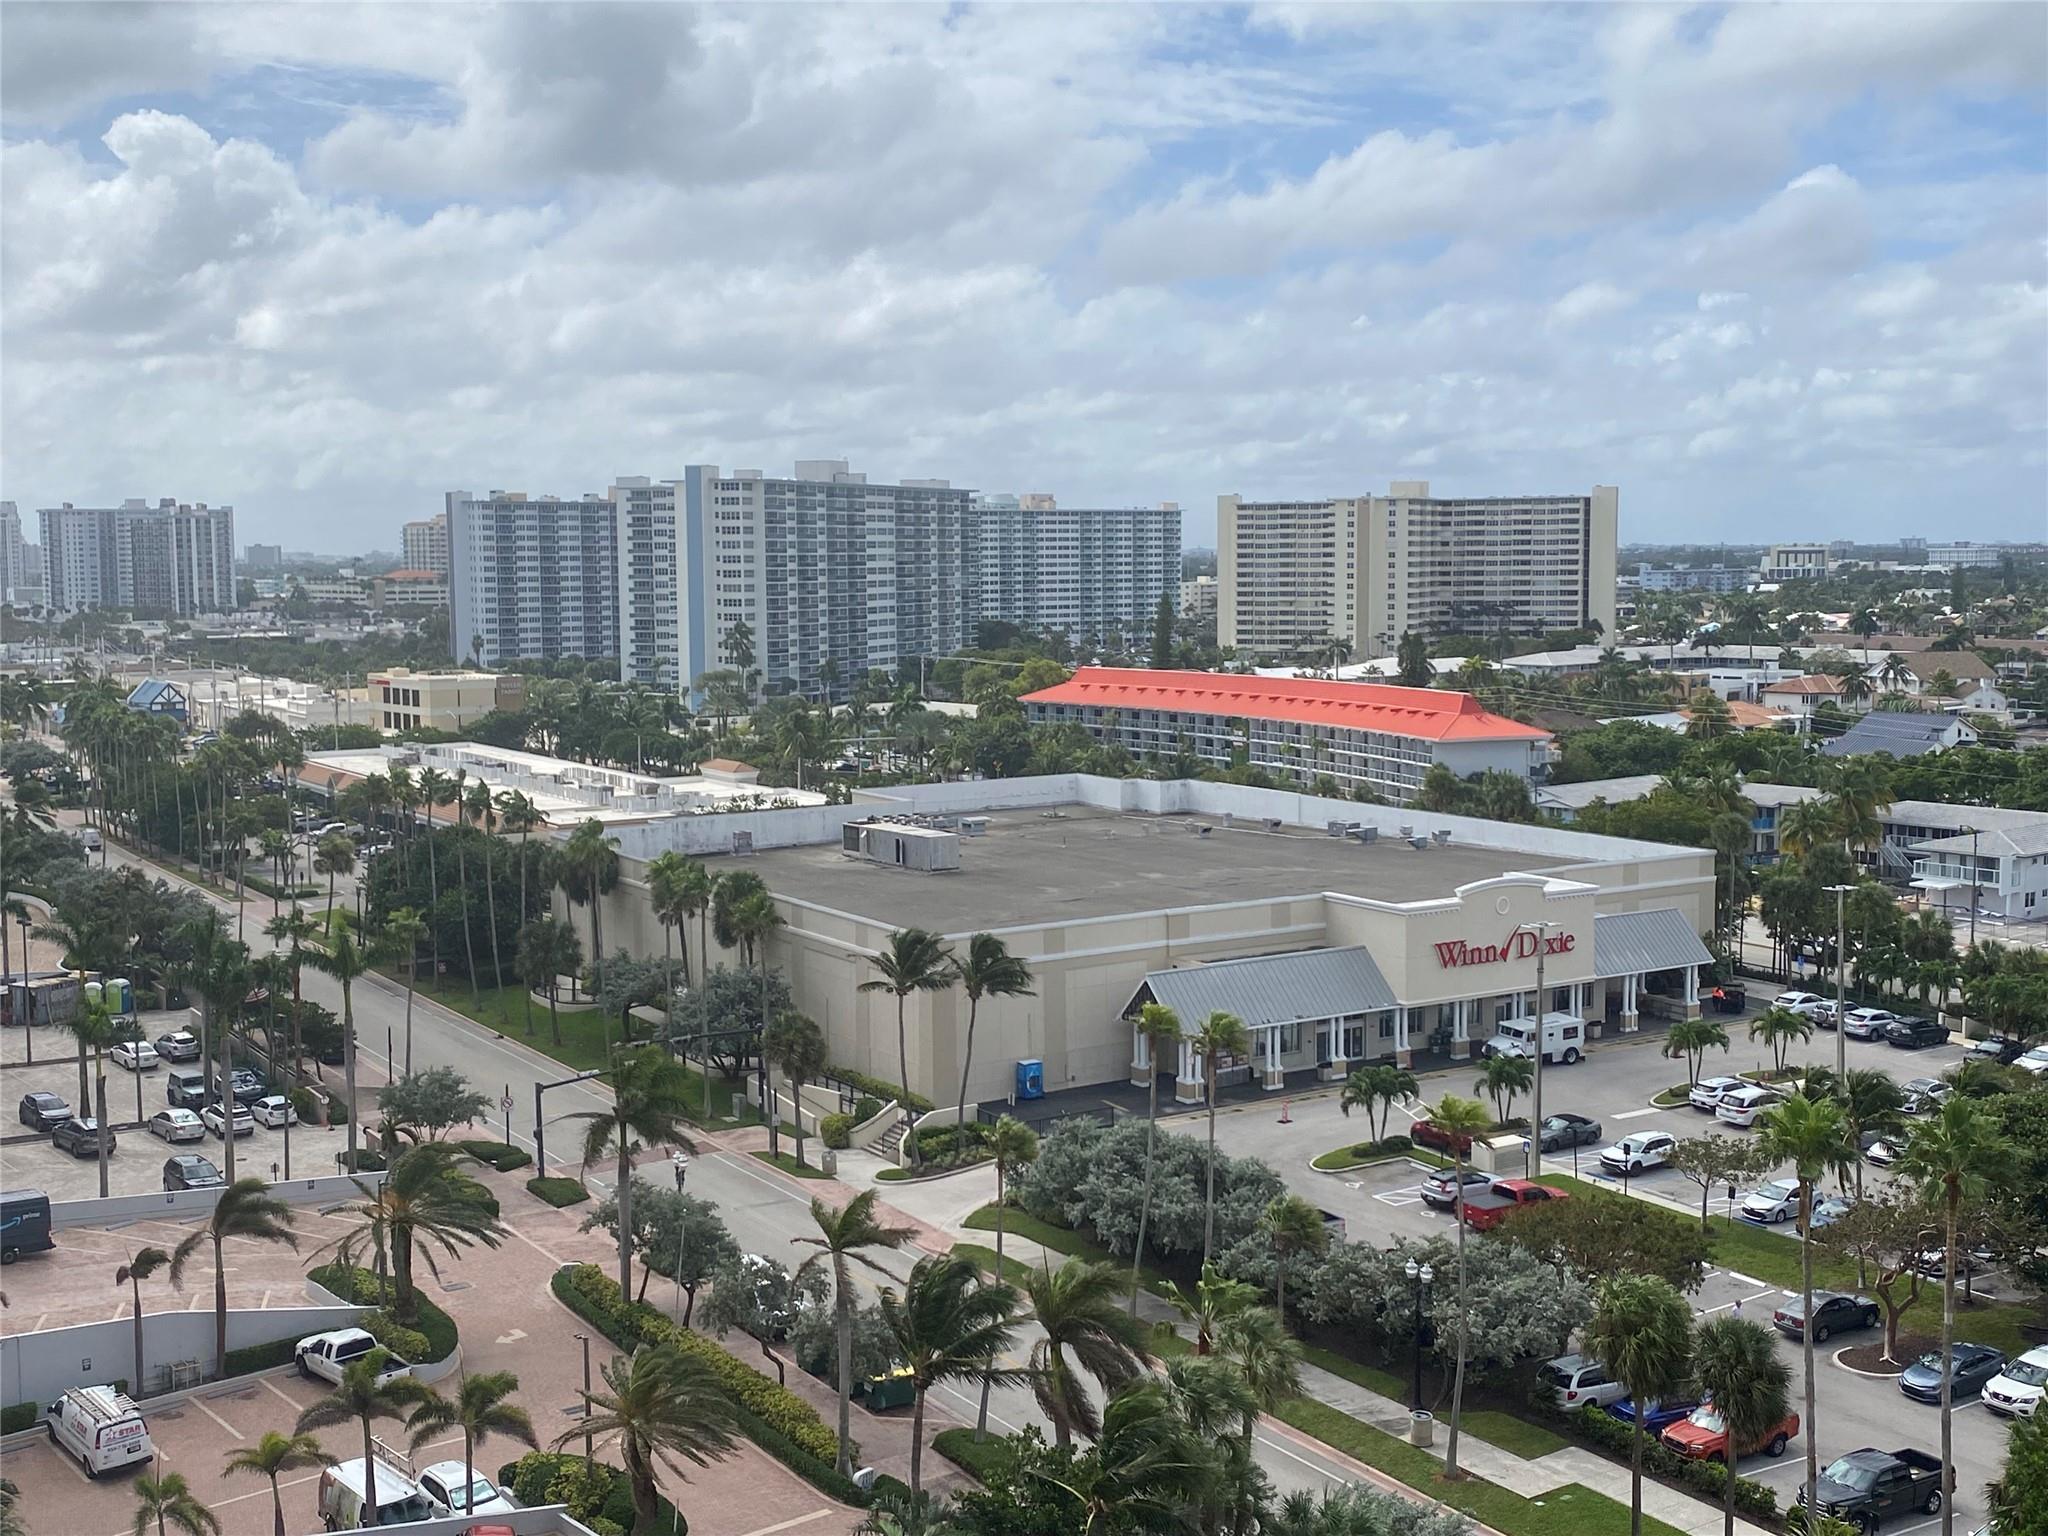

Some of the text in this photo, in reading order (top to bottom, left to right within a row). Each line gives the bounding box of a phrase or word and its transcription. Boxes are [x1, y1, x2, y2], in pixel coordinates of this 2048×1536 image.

[1434, 931, 1576, 969] Winn Dxie
[119, 1425, 141, 1436] STAR
